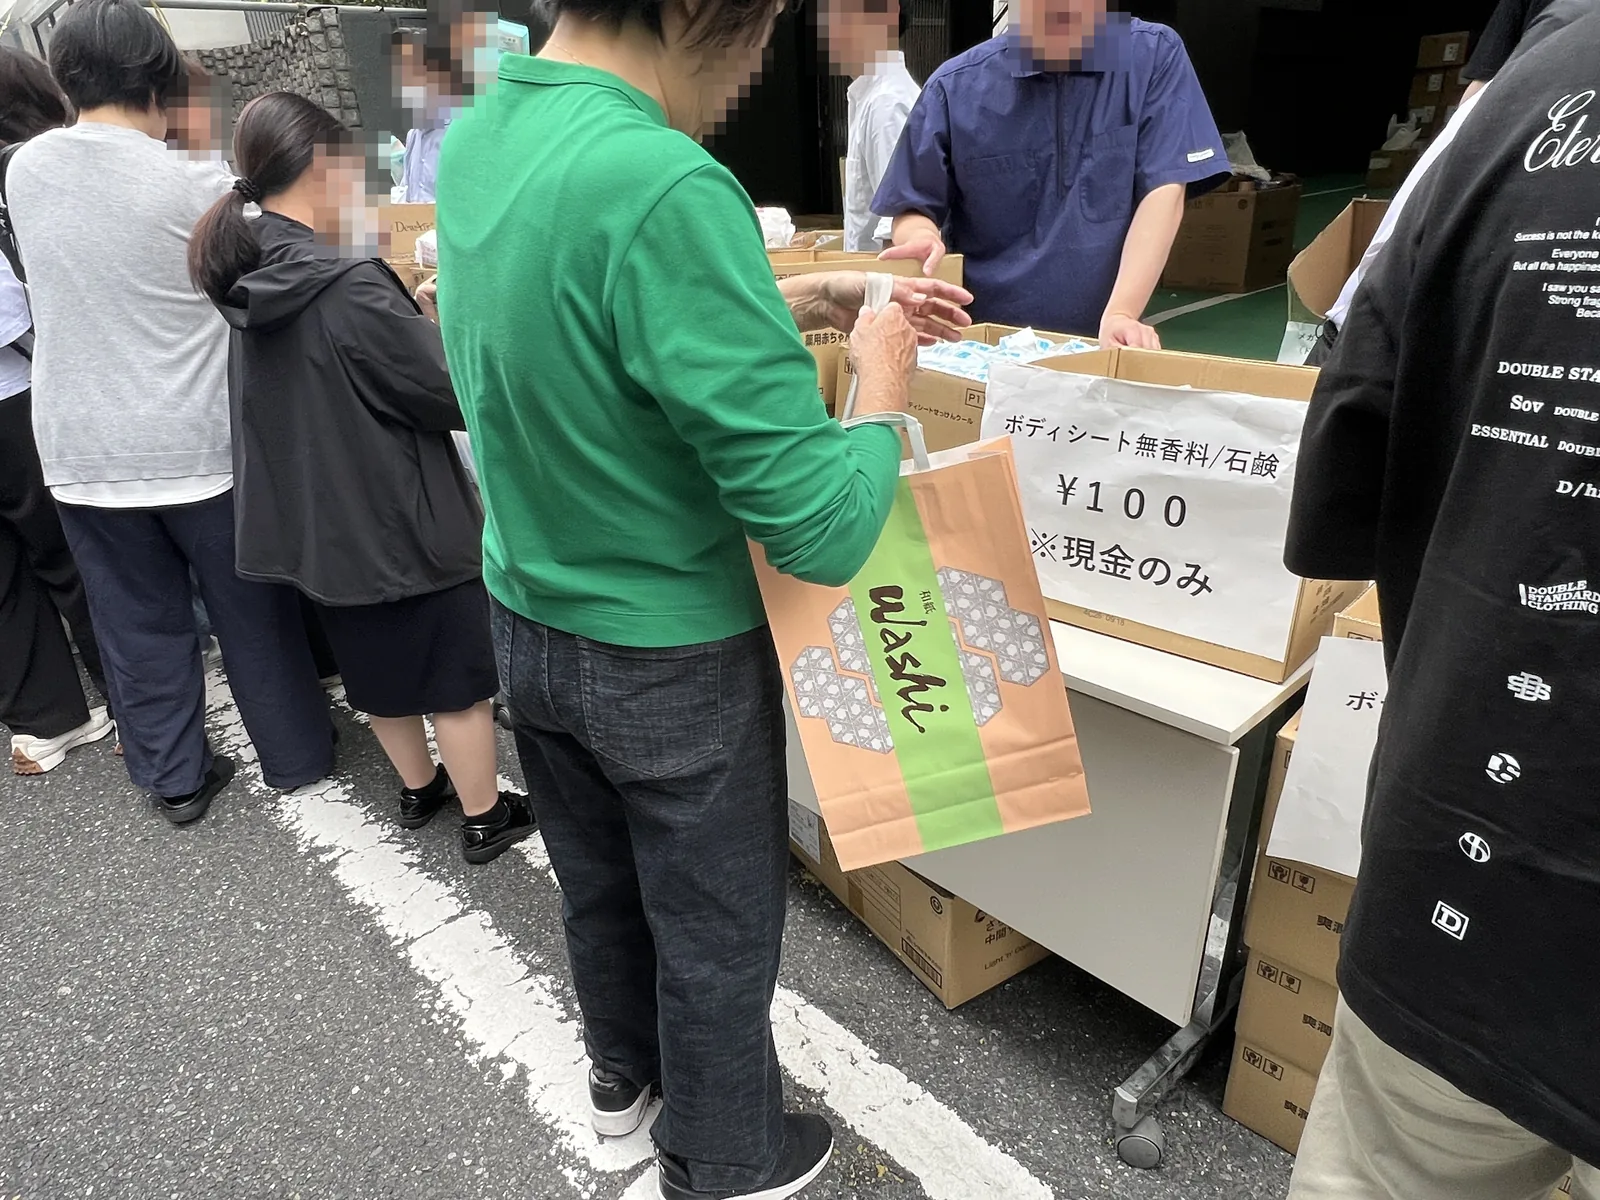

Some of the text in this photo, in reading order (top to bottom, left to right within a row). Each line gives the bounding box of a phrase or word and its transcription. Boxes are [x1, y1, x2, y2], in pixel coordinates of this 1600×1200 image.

[1547, 231, 1555, 240] is
[1556, 230, 1572, 240] not
[1573, 229, 1590, 240] the
[1551, 248, 1600, 260] Everyone
[1512, 261, 1527, 271] But
[1527, 261, 1539, 271] all
[1540, 261, 1555, 271] the
[1542, 282, 1548, 292] I
[1567, 285, 1588, 294] you
[1548, 294, 1581, 308] Strong
[1497, 361, 1564, 379] DOUBLE
[1510, 394, 1600, 422] Sov DOUBLE
[1470, 424, 1549, 449] ESSENTIAL
[1528, 580, 1587, 595] DOUBLE
[1527, 600, 1599, 615] CLOTHING
[1345, 691, 1386, 711] ボ
